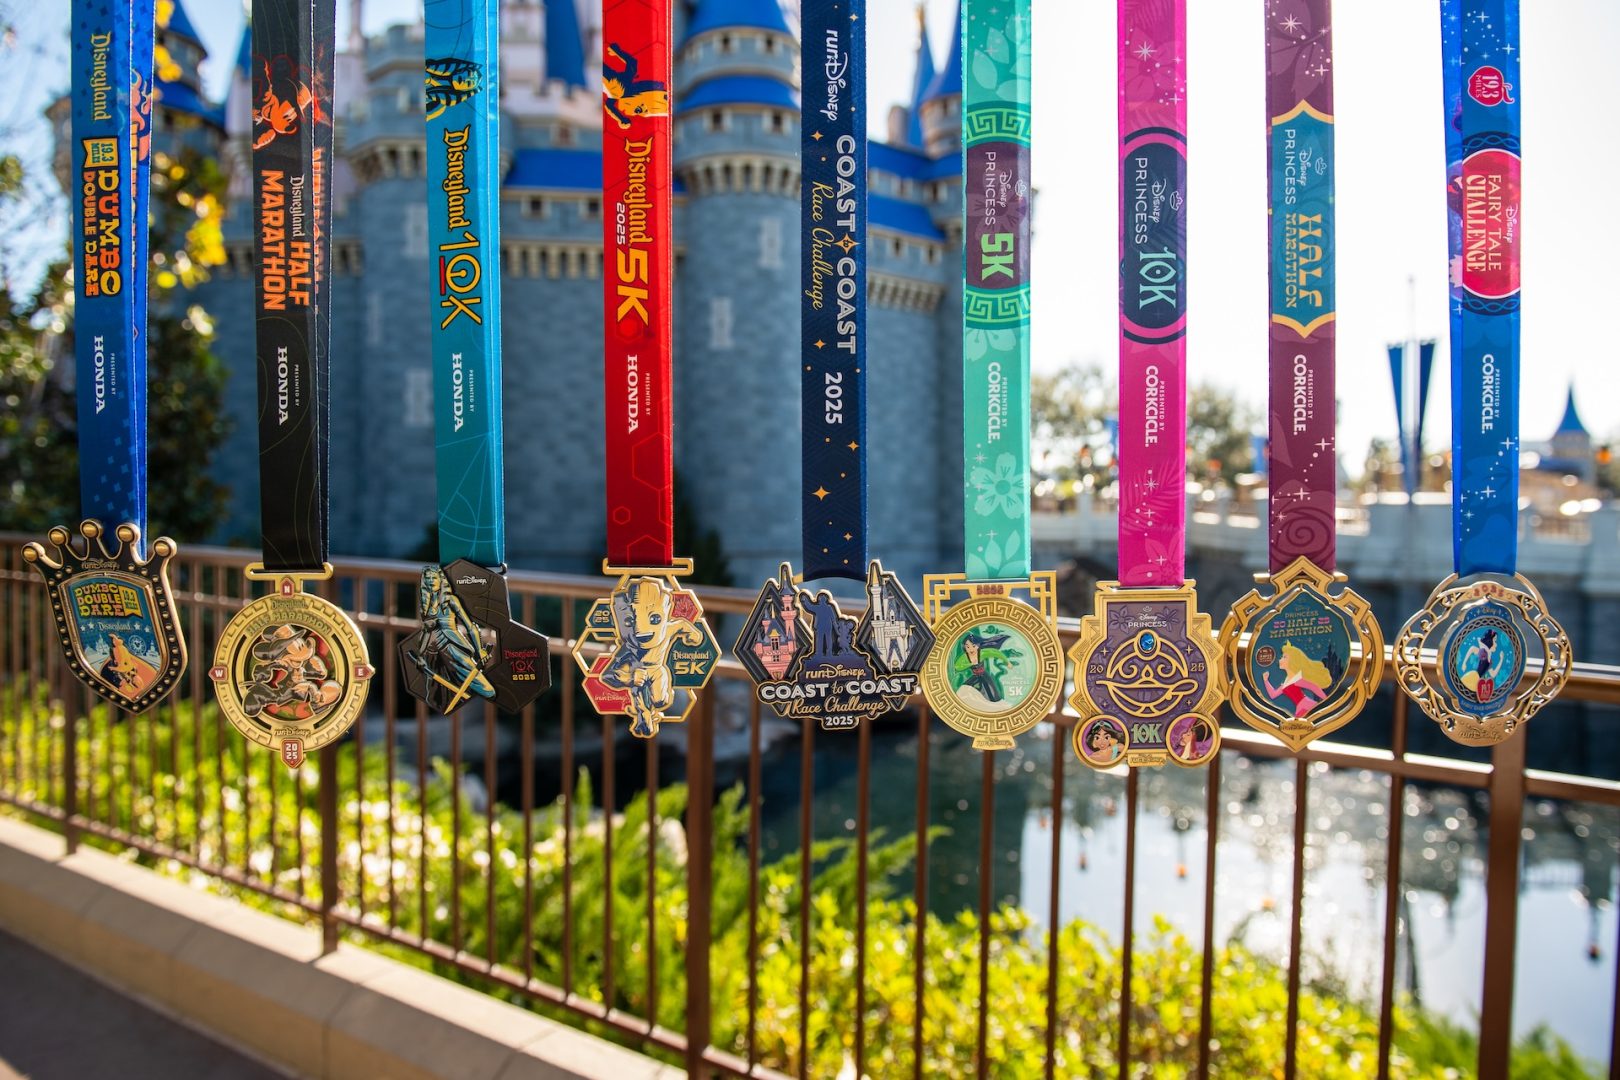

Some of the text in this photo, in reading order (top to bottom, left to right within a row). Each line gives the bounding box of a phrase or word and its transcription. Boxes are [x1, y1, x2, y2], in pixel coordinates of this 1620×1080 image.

[91, 31, 112, 121] Disneyland
[1481, 74, 1499, 99] 19.3
[101, 143, 114, 163] 19.3
[1284, 129, 1296, 205] PRINCESS
[1298, 147, 1313, 186] Disney
[624, 137, 654, 245] Disneyland
[836, 135, 856, 232] COAST
[985, 151, 996, 226] PRINCESS
[1000, 169, 1013, 208] Disney
[1135, 157, 1148, 245] PRINCESS
[1152, 178, 1167, 223] Disney
[83, 171, 99, 298] DOUBLE DARE
[98, 170, 121, 297] DUMBO
[261, 170, 287, 311] MARATHON
[289, 174, 310, 307] Disneyland HALF
[439, 125, 482, 330] Disneyland 10K
[616, 203, 626, 245] 2025
[1466, 174, 1487, 272] CHALLENGE
[1488, 174, 1502, 271] FAIRY TALE
[1503, 203, 1518, 243] Disney
[805, 181, 835, 311] Race Challenge
[981, 233, 1014, 281] 5K
[1285, 213, 1297, 308] MARATHON
[1299, 213, 1322, 308] HALF
[616, 248, 649, 327] 5K
[1139, 246, 1176, 310] 10K
[837, 257, 857, 354] COAST
[94, 335, 106, 415] HONDA
[277, 346, 289, 425] HONDA
[452, 353, 465, 432] HONDA
[627, 354, 638, 434] HONDA
[825, 372, 842, 424] 2025
[74, 583, 120, 598] DUMBO
[77, 592, 121, 605] DOUBLE
[284, 585, 290, 594] N
[79, 604, 125, 618] DARE
[247, 609, 331, 636] HALF MARATHON
[1128, 620, 1167, 629] PRINCESS
[1270, 624, 1333, 639] MARATHON
[1287, 617, 1316, 628] HALF
[214, 669, 224, 678] W
[357, 668, 364, 677] E
[672, 650, 710, 662] Disneyland
[674, 662, 705, 676] 5K
[1089, 664, 1104, 675] 20
[1190, 663, 1205, 673] 25
[761, 677, 916, 701] COAST to COAST
[792, 695, 886, 716] Race Challenge
[1008, 686, 1023, 697] 5K
[825, 715, 855, 726] 2025
[1131, 722, 1163, 745] 10K
[285, 743, 299, 752] 20
[285, 751, 299, 760] 25
